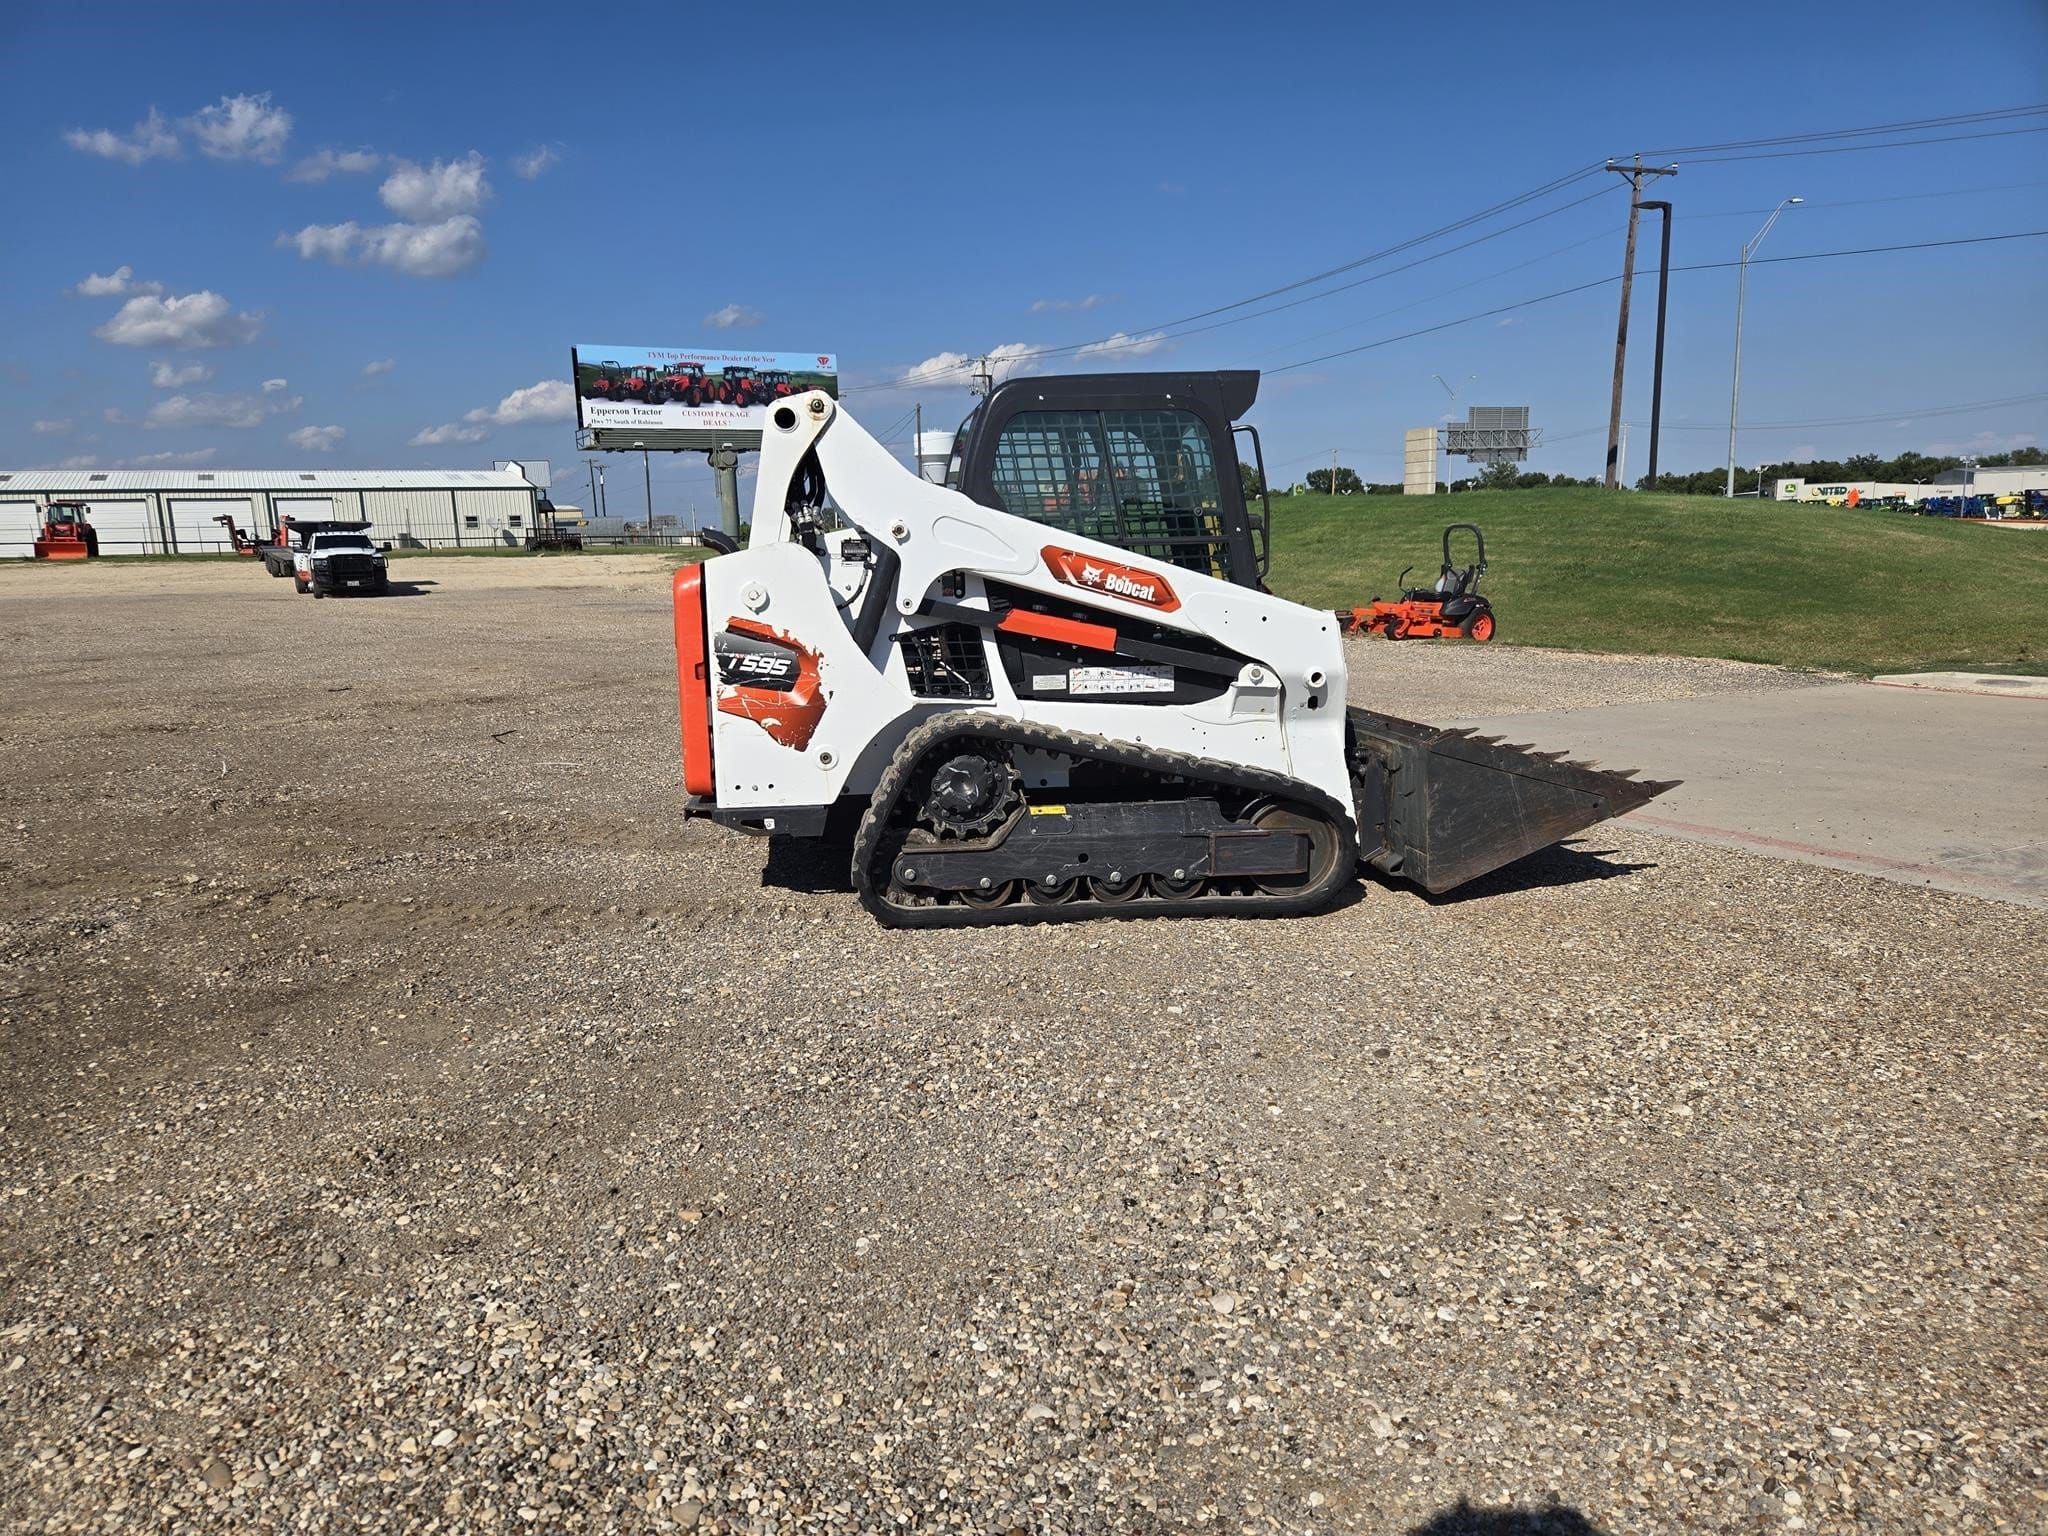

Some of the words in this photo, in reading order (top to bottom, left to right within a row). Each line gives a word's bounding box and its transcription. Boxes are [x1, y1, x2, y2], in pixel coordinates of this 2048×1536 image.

[680, 353, 720, 361] Performance
[590, 406, 630, 417] Epperson
[631, 407, 663, 416] Tractor
[1105, 573, 1154, 602] Bobcat
